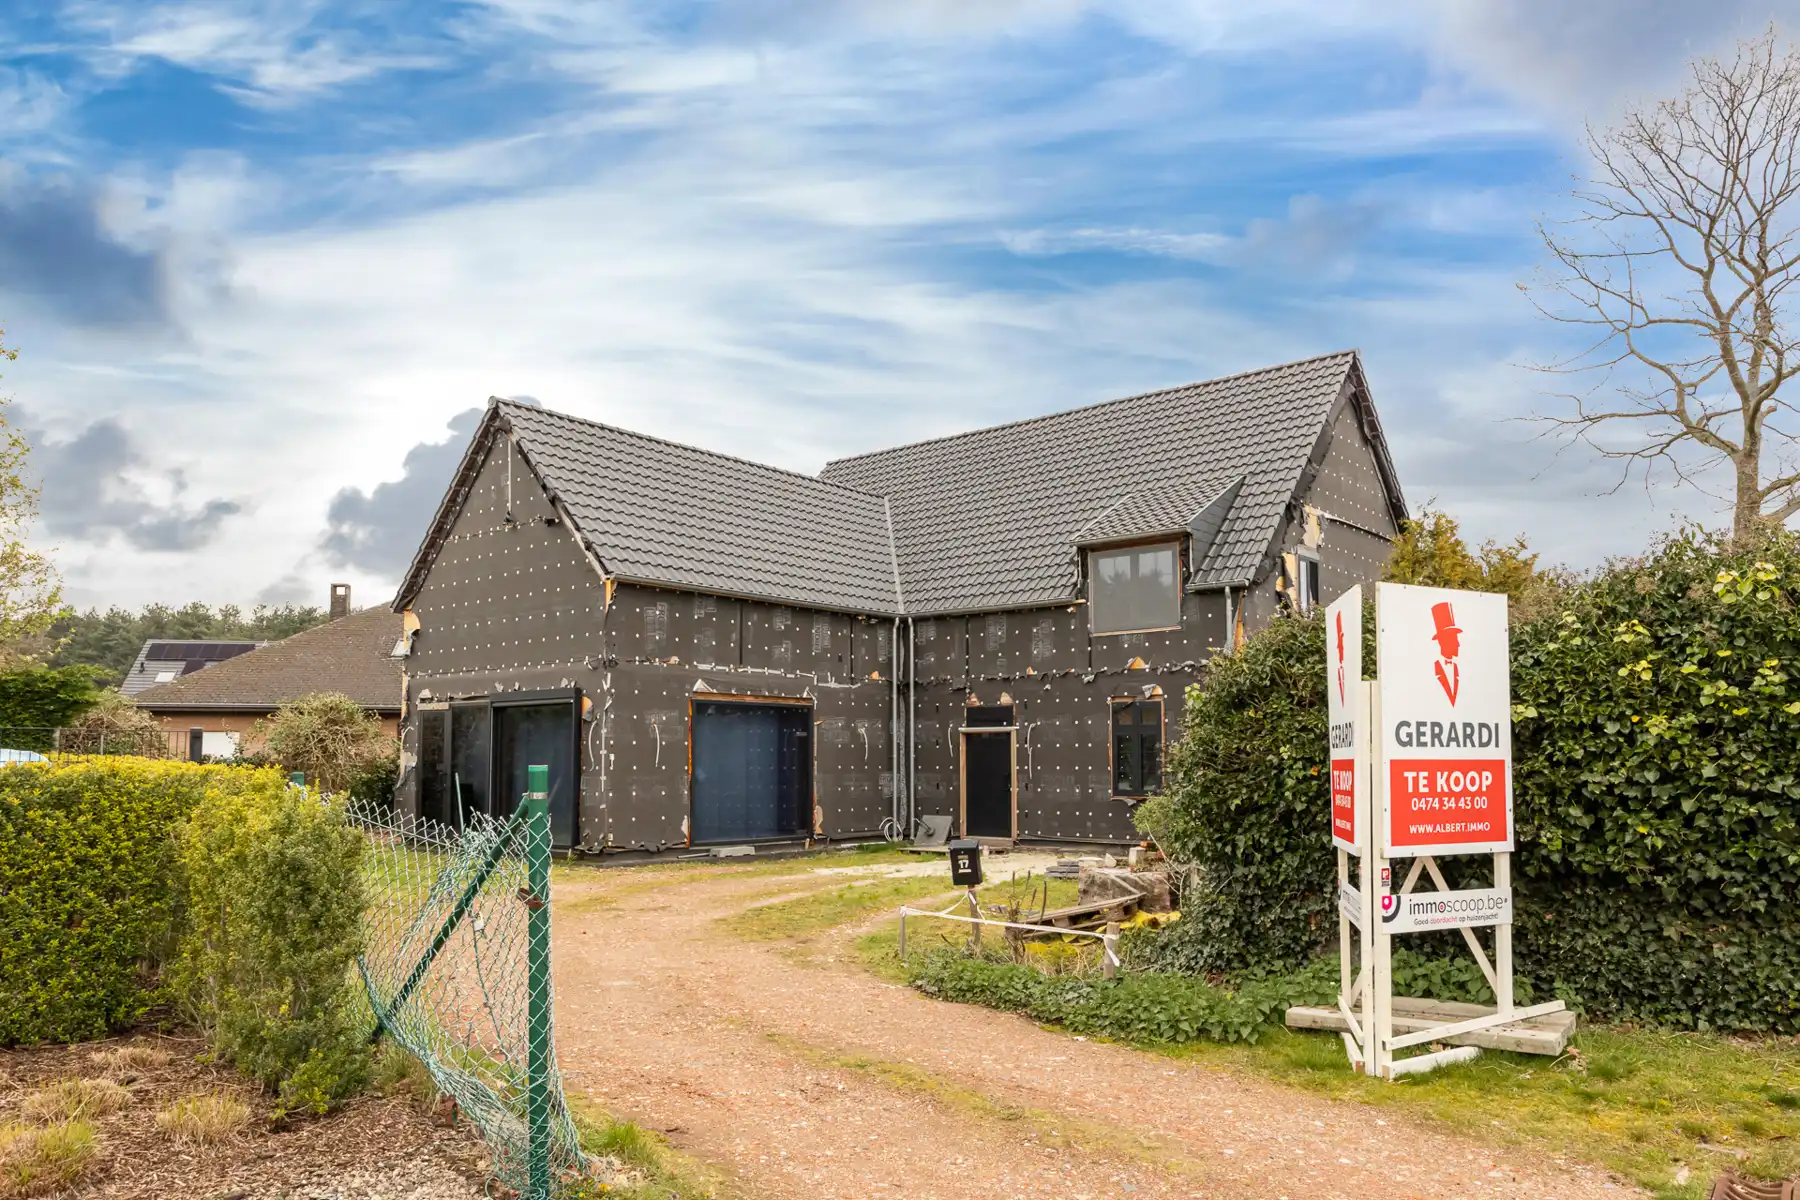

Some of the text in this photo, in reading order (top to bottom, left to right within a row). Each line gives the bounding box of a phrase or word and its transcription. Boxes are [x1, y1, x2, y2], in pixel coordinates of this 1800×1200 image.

[1395, 720, 1500, 748] GERARDI
[1403, 770, 1493, 793] TE KOOP
[1411, 796, 1488, 811] 0474 34 43 00
[1409, 821, 1491, 834] WWW.ALBERT.IMMO
[958, 859, 969, 869] 17
[1413, 918, 1429, 926] Goed
